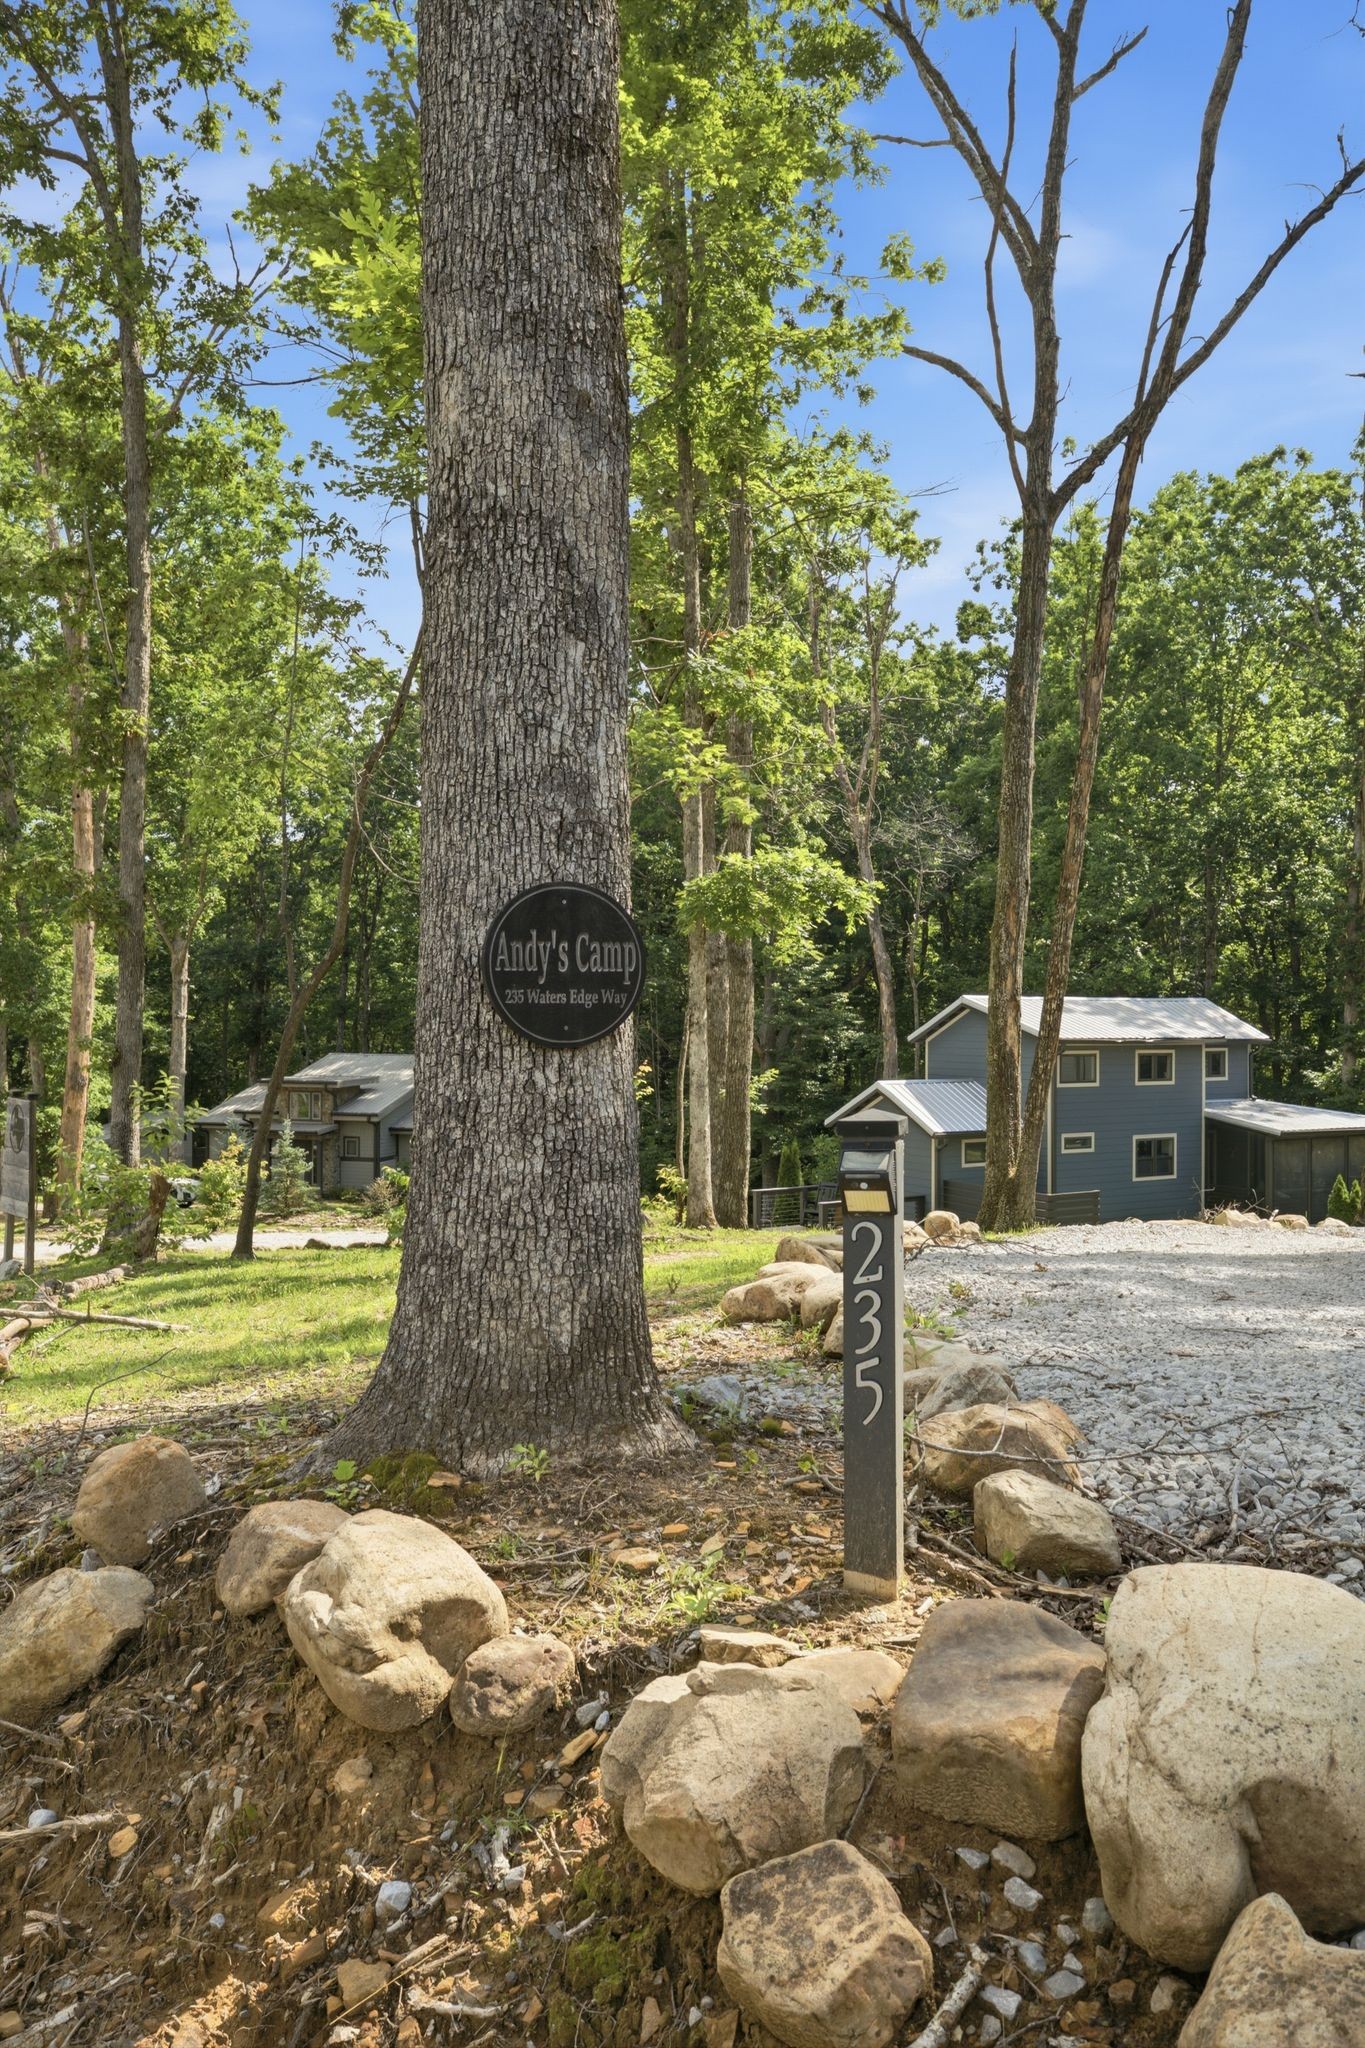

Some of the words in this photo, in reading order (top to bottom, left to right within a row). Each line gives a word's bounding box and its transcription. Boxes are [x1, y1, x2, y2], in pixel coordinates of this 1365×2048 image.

[495, 929, 569, 985] Andy's
[575, 932, 637, 985] Camp
[505, 989, 524, 1004] 235
[527, 989, 567, 1004] Waters
[569, 989, 599, 1008] Edge
[601, 989, 628, 1008] Way
[851, 1221, 883, 1426] 235
